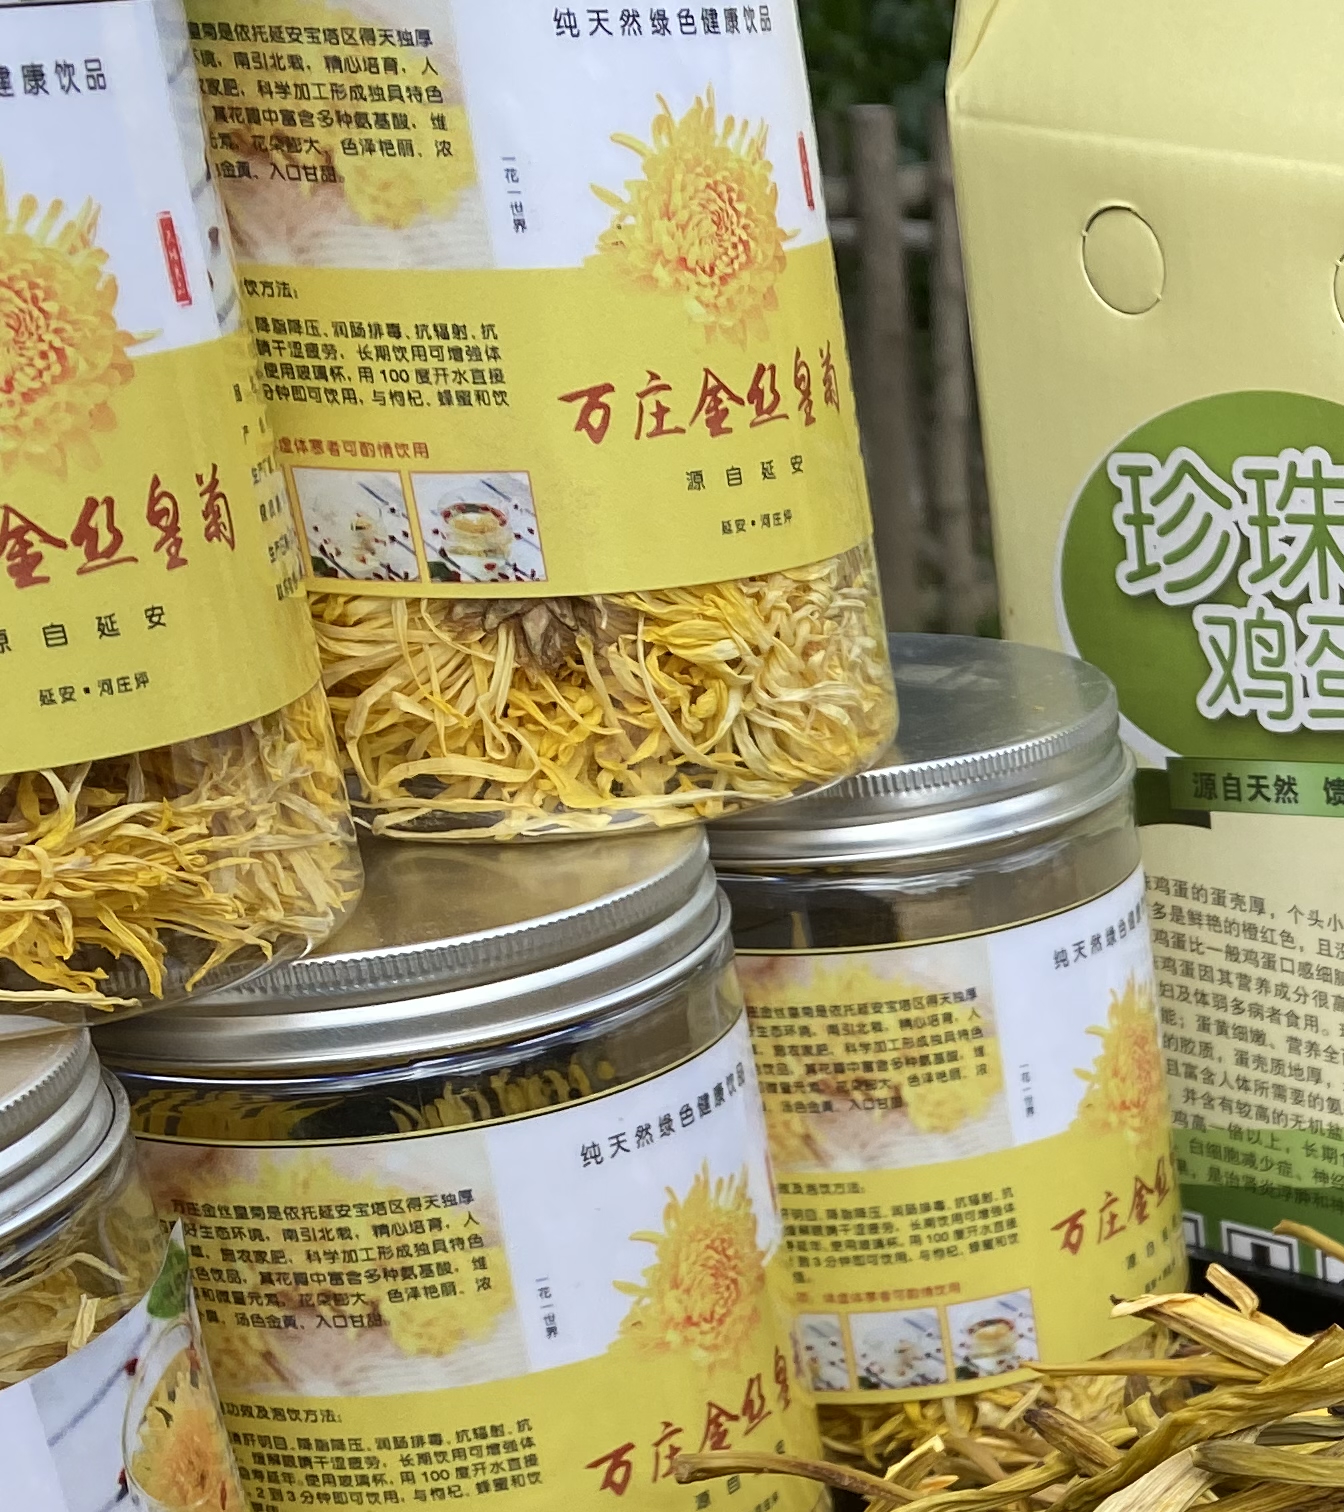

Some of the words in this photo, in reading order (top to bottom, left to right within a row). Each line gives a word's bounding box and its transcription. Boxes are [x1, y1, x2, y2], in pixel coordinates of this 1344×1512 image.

[553, 5, 772, 38] 纯天然绿色健康饮品
[685, 454, 805, 491] 源自延安
[1192, 771, 1299, 805] 源自天然
